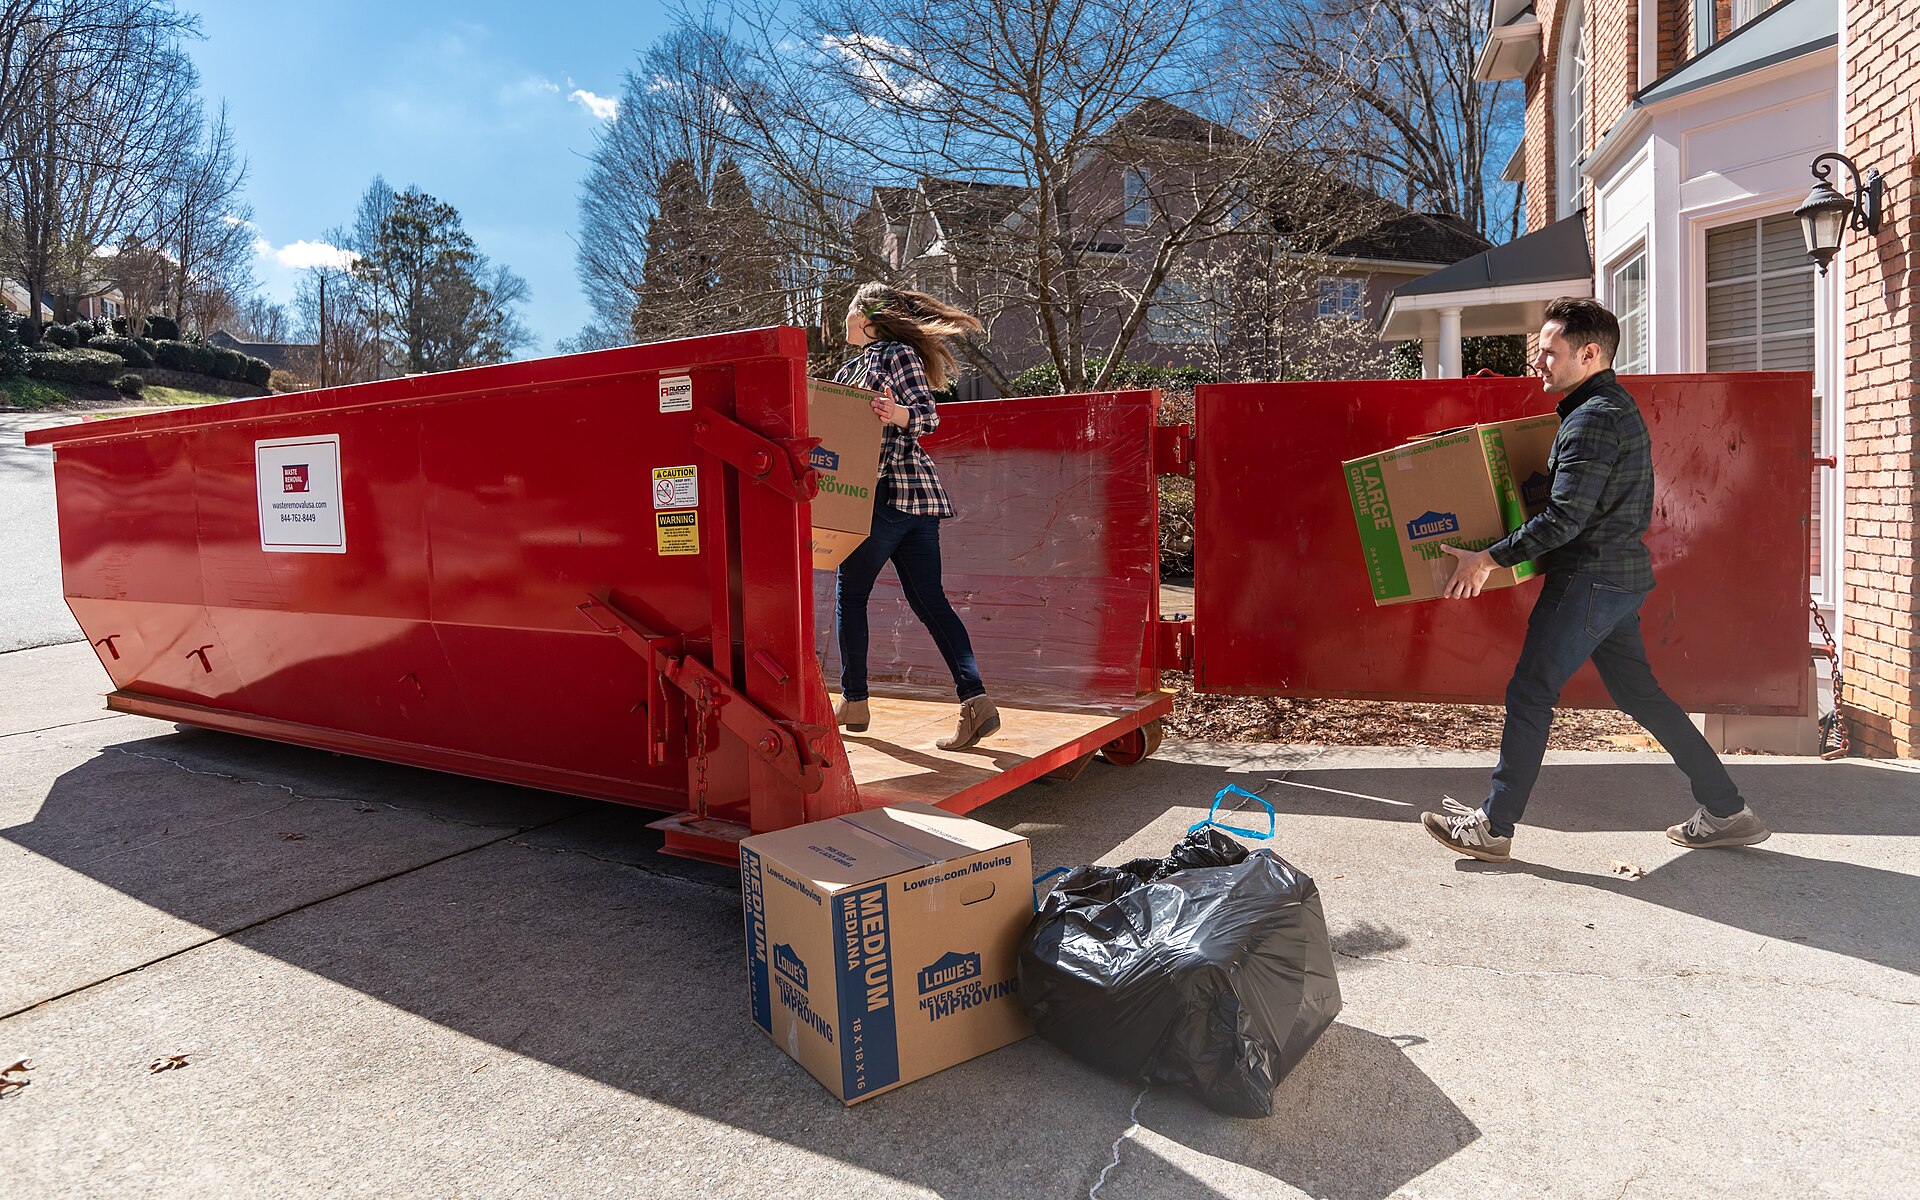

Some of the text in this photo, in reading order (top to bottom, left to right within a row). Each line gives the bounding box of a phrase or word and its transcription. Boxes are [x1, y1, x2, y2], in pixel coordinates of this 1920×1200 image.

[1382, 435, 1470, 463] Lowes.com/Moving
[1484, 434, 1502, 487] GRANDE
[284, 468, 298, 476] WASTE
[662, 468, 694, 478] CAUTION
[1491, 432, 1517, 504] LARGE
[285, 483, 294, 491] USA
[818, 479, 869, 499] ROVING
[1350, 467, 1371, 516] GRANDE
[1361, 462, 1392, 531] LARGE
[272, 500, 327, 509] wasteremovalusa.com
[280, 513, 316, 522] 844-762-8449
[659, 514, 695, 525] WARNING
[1412, 517, 1454, 537] LOWE'S
[1412, 541, 1439, 552] NEVER
[742, 850, 753, 914] MEDIANA
[766, 863, 822, 906] Lowes.com/Moving
[903, 856, 1012, 892] Lowes.com/Moving
[749, 854, 766, 964] MEDIUM
[843, 895, 861, 972] MEDIANA
[859, 888, 890, 1013] MEDIUM
[776, 949, 805, 985] LOWE'S
[924, 959, 975, 990] LOWE'S
[774, 973, 809, 1006] NEVER STOP
[919, 980, 982, 1011] NEVER STOP
[929, 977, 1019, 1022] IMPROVING
[852, 1017, 866, 1090] 18 X 18 X 16
